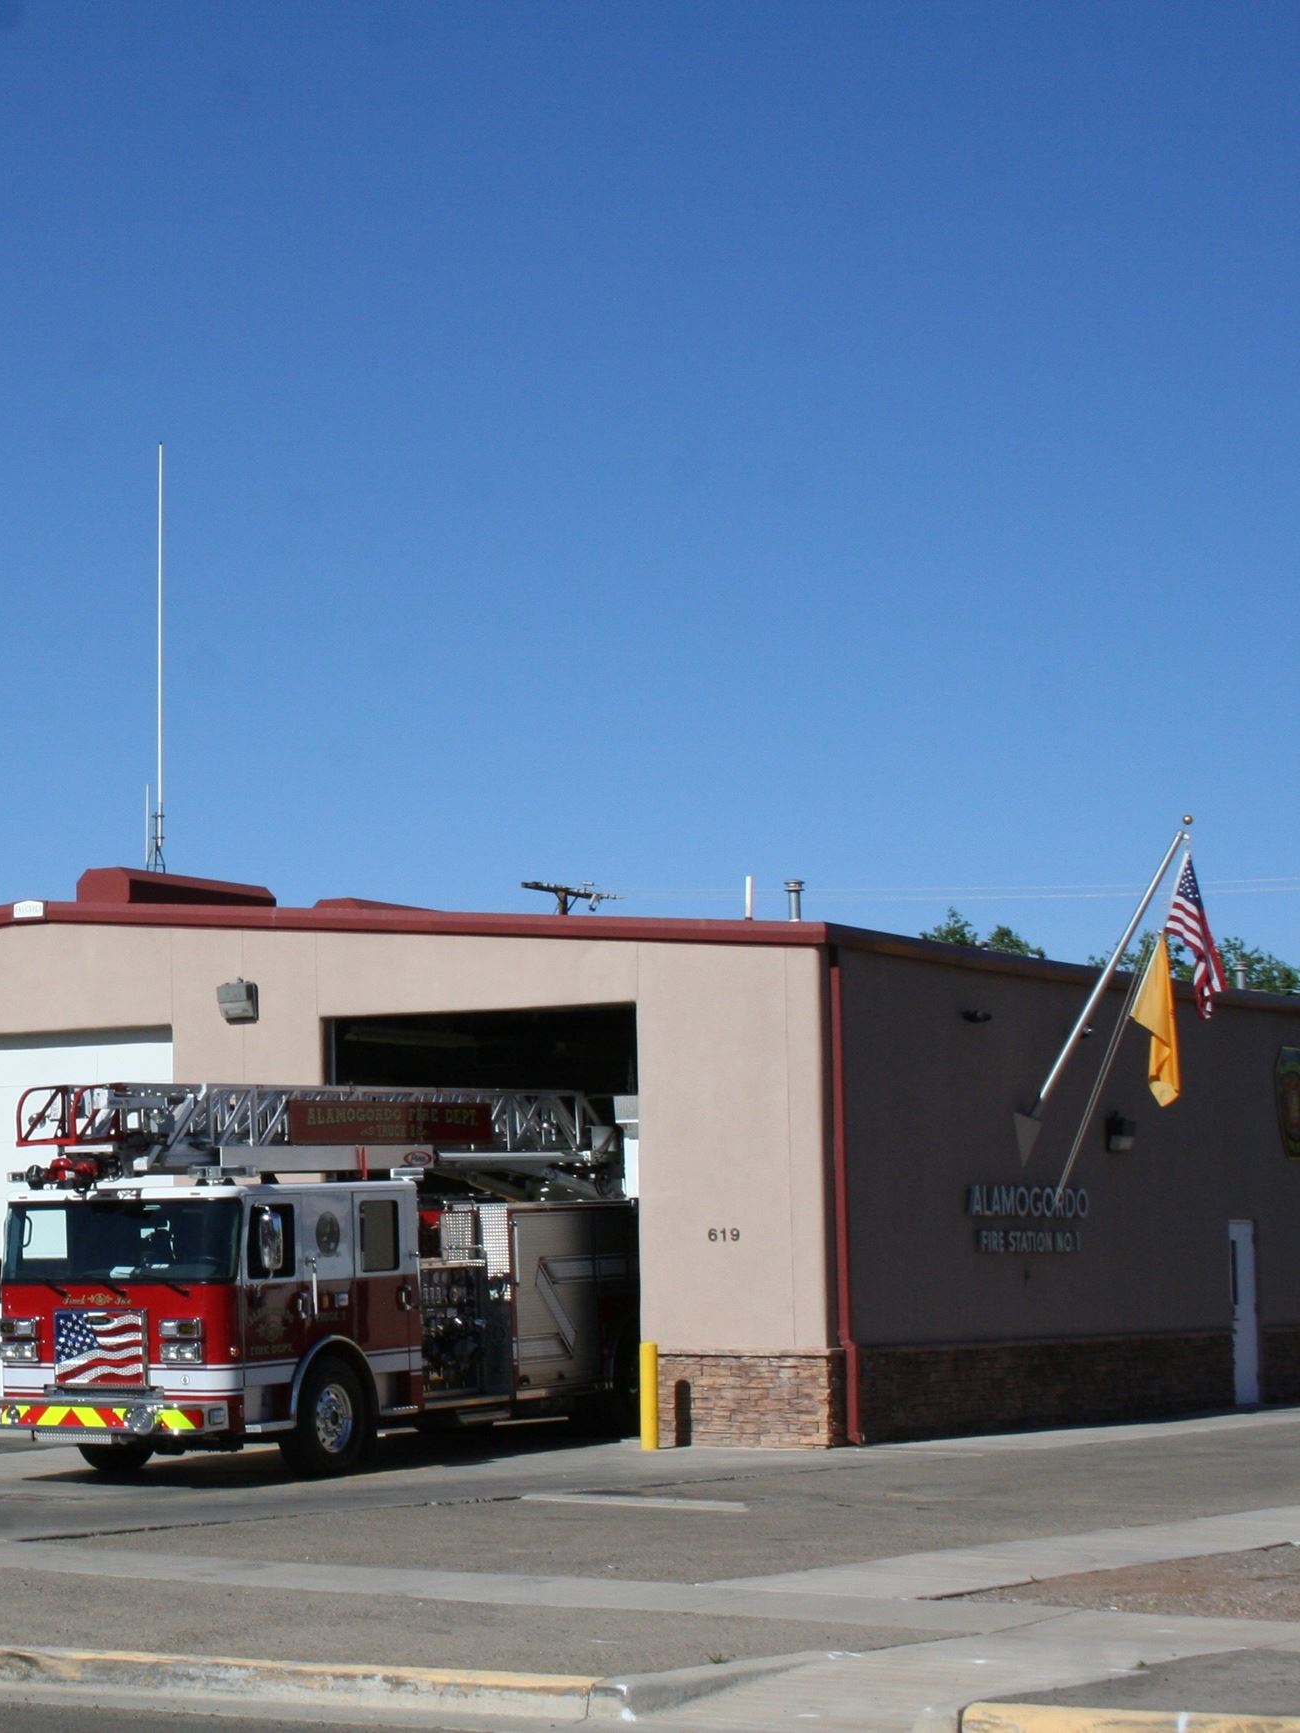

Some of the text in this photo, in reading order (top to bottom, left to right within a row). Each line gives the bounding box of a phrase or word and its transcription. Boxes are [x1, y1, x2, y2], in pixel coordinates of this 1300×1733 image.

[307, 1107, 402, 1126] ALAMOGORDO
[408, 1108, 439, 1123] FIRE
[971, 1184, 1089, 1218] ALAMOGORDO
[708, 1227, 740, 1242] 619
[980, 1230, 1005, 1253] FIRE
[1008, 1230, 1053, 1253] STATION
